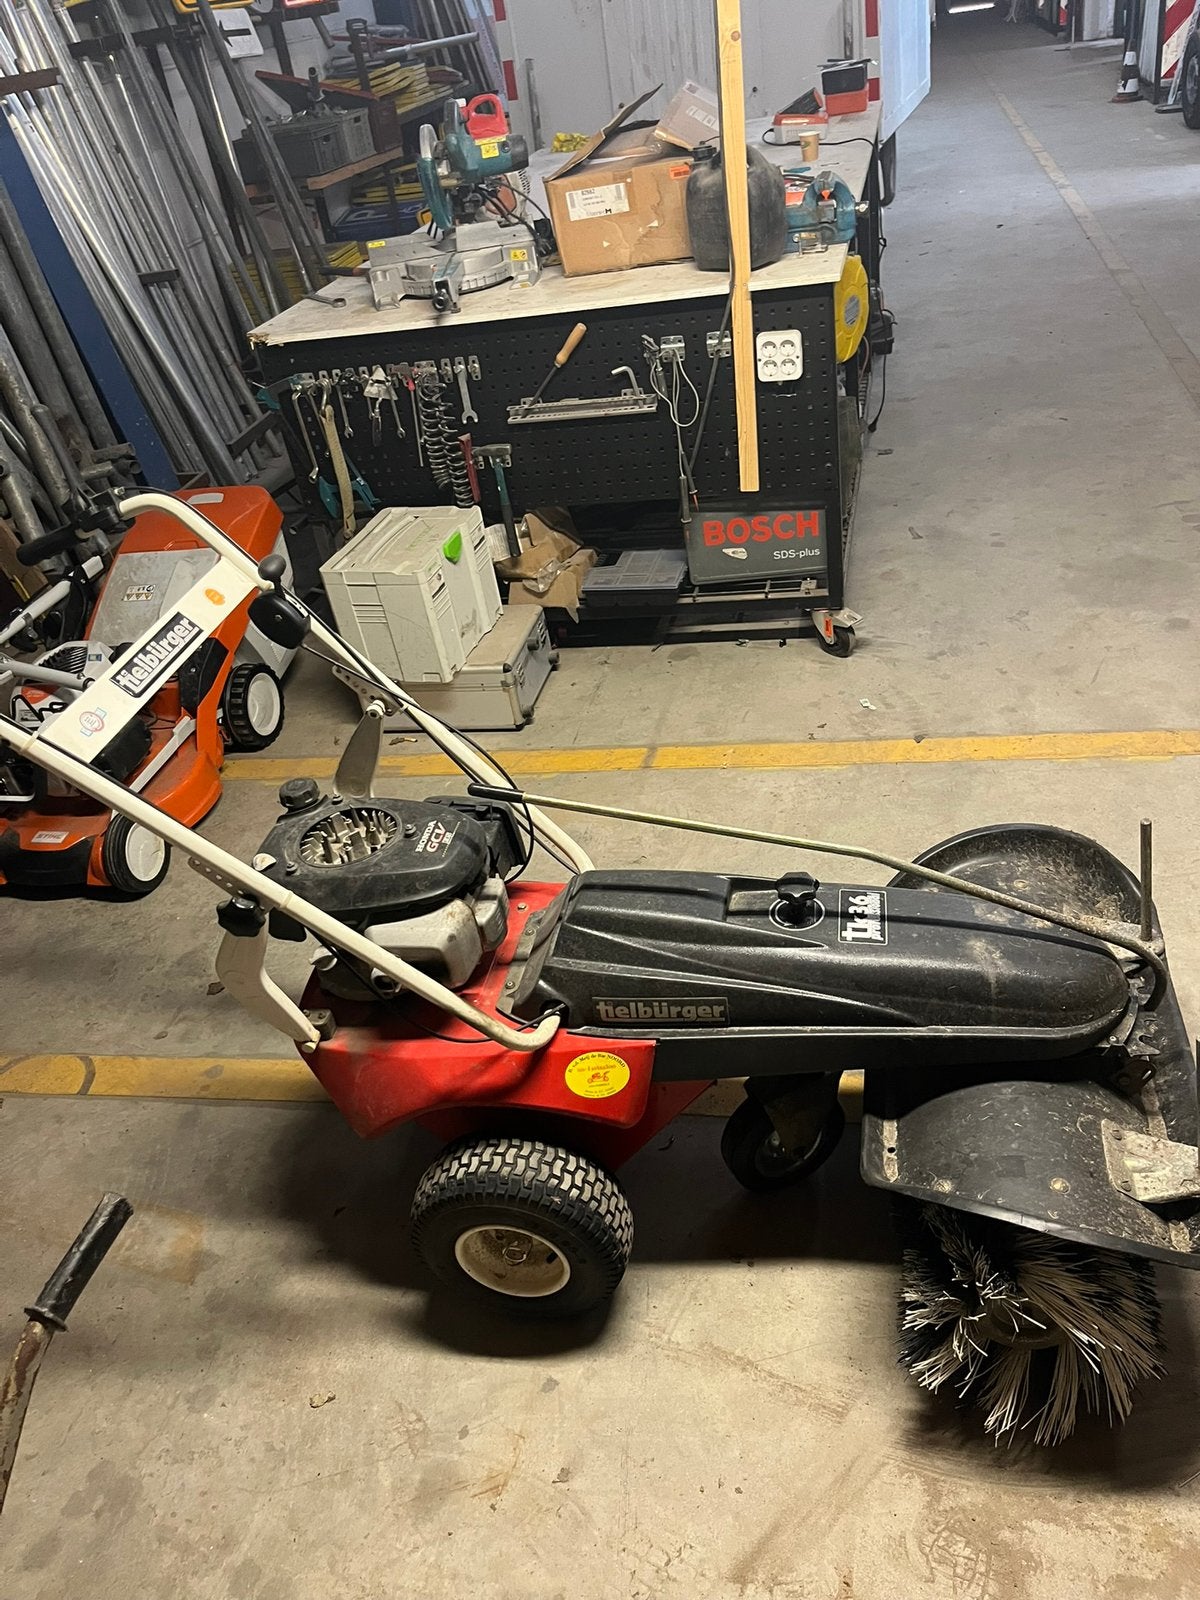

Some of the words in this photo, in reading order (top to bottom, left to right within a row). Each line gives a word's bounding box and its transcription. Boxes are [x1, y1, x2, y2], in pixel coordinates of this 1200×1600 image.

[702, 511, 820, 547] BOSCH
[773, 548, 821, 560] SDS-plus
[115, 617, 198, 693] tielbürger
[415, 820, 437, 853] HONDA
[426, 822, 447, 853] GCV
[848, 895, 870, 914] 36
[596, 1001, 726, 1021] tielbürger
